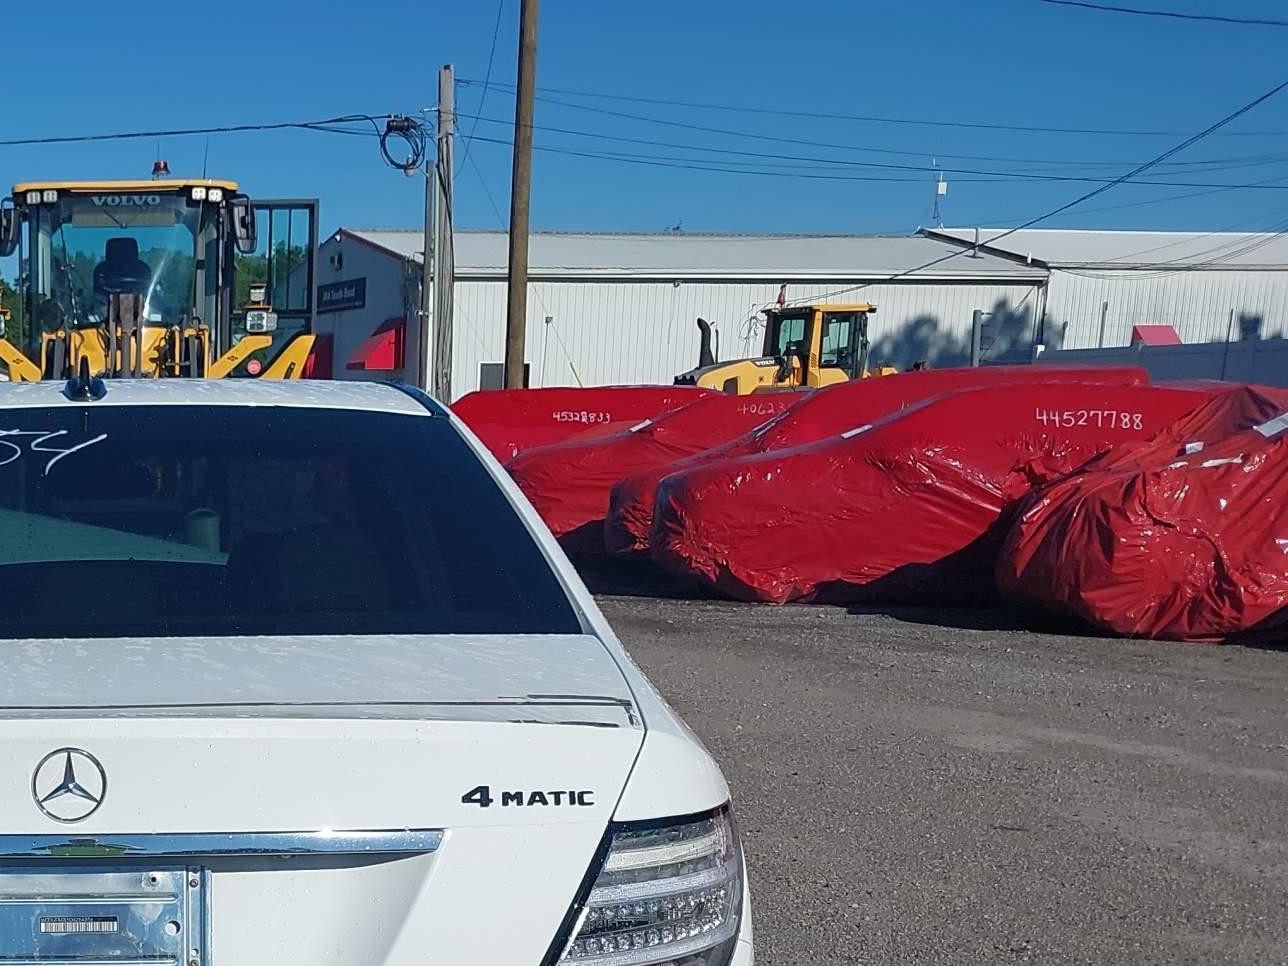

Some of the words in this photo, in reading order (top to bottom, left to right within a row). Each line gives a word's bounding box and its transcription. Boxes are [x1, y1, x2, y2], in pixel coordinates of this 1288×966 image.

[91, 195, 161, 206] VOLVO
[1035, 407, 1143, 430] 44527788
[501, 789, 596, 808] MATIC
